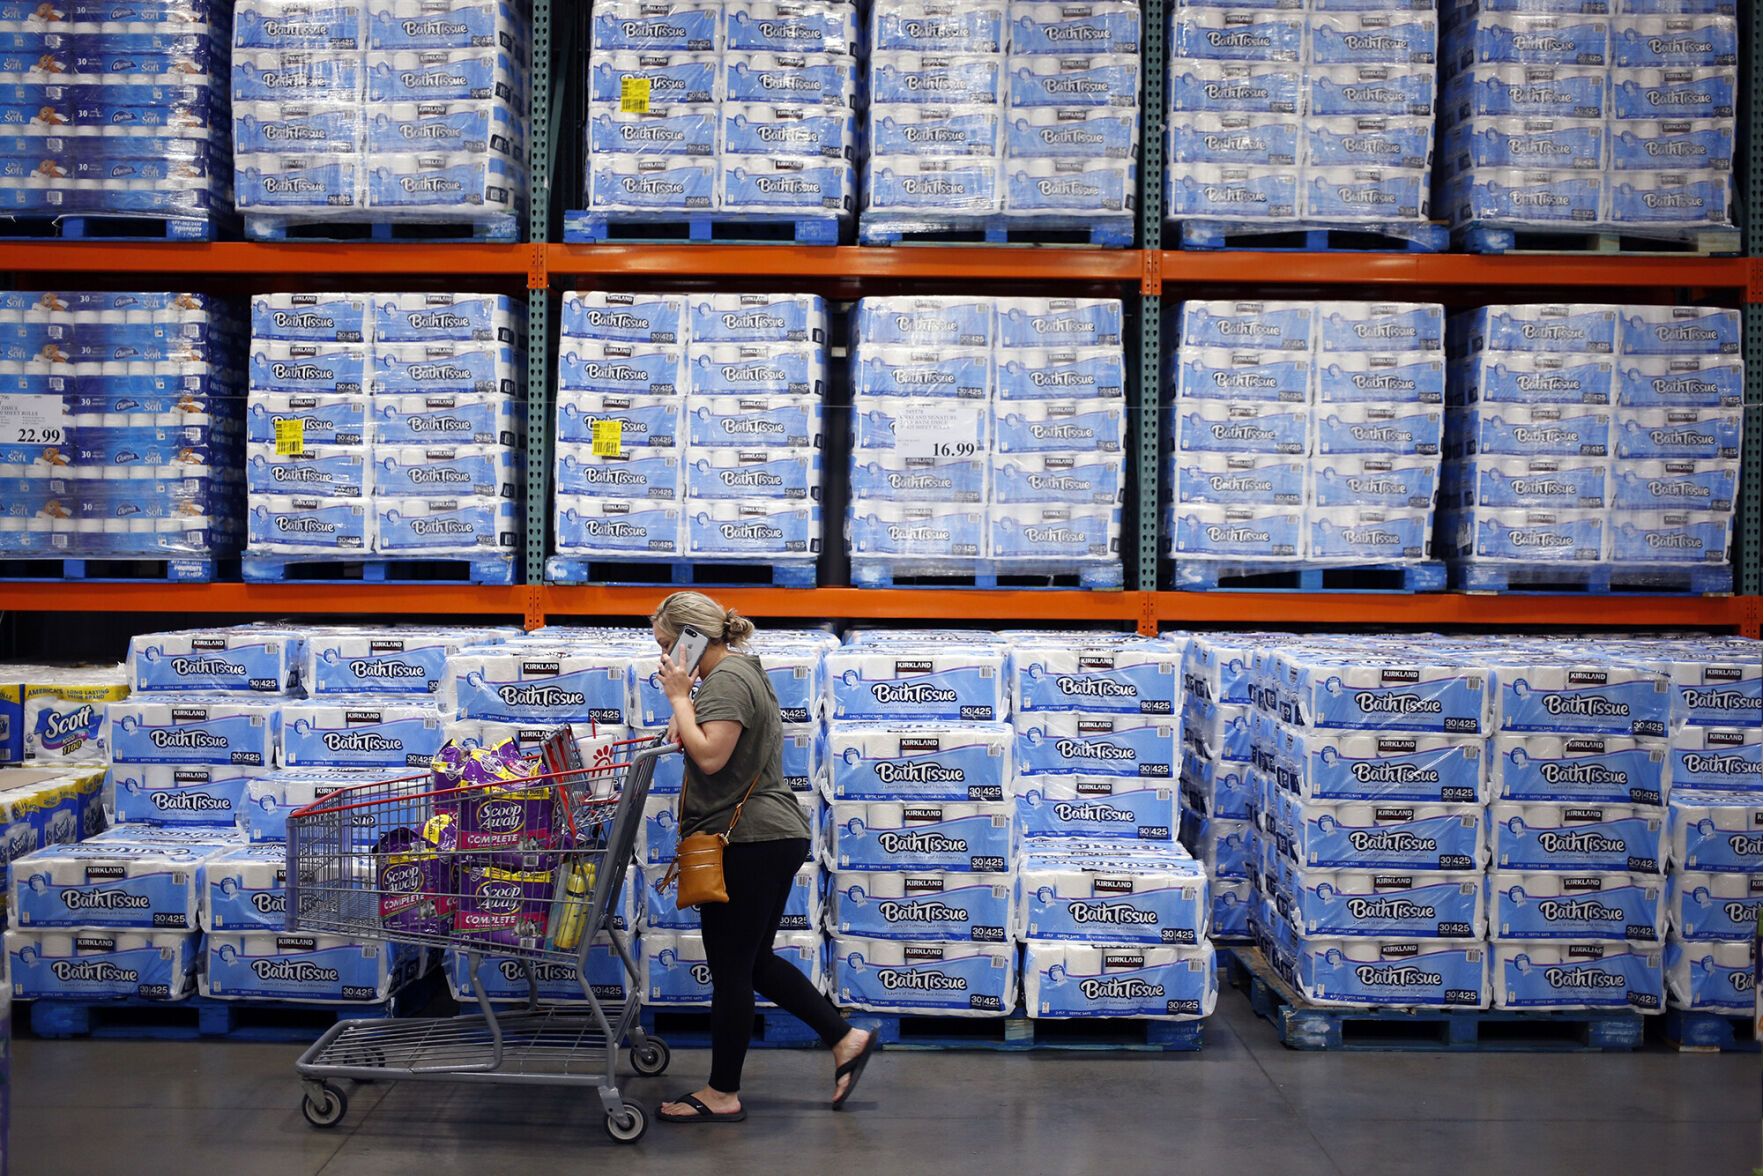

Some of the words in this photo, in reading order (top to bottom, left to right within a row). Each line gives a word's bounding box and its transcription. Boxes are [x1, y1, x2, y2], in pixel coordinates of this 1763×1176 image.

[7, 299, 25, 308] Soft
[17, 428, 60, 443] 22.99
[933, 443, 975, 457] 16.99
[8, 454, 26, 462] Soft
[145, 454, 162, 463] Soft
[524, 663, 559, 671] KIRKLAND
[897, 661, 932, 669] KIRKLAND
[1570, 672, 1606, 680] KIRKLAND
[1707, 669, 1742, 677] KIRKLAND
[27, 688, 64, 697] AMERICA'S
[84, 687, 110, 695] LASTING
[346, 713, 380, 721] KIRKLAND
[45, 704, 93, 739] Scott
[1709, 734, 1743, 742] KIRKLAND
[62, 740, 82, 756] 1100
[1568, 741, 1604, 749] KIRKLAND
[480, 801, 522, 818] Scoop
[905, 809, 941, 817] KIRKLAND
[478, 814, 520, 829] Away
[467, 833, 518, 844] COMPLETE
[384, 865, 419, 885] Scoop
[1096, 880, 1132, 888] KIRKLAND
[1376, 877, 1412, 885] KIRKLAND
[480, 885, 521, 898] Scoop
[465, 914, 516, 925] COMPLETE
[278, 938, 314, 946] KIRKLAND
[1382, 945, 1418, 953] KIRKLAND
